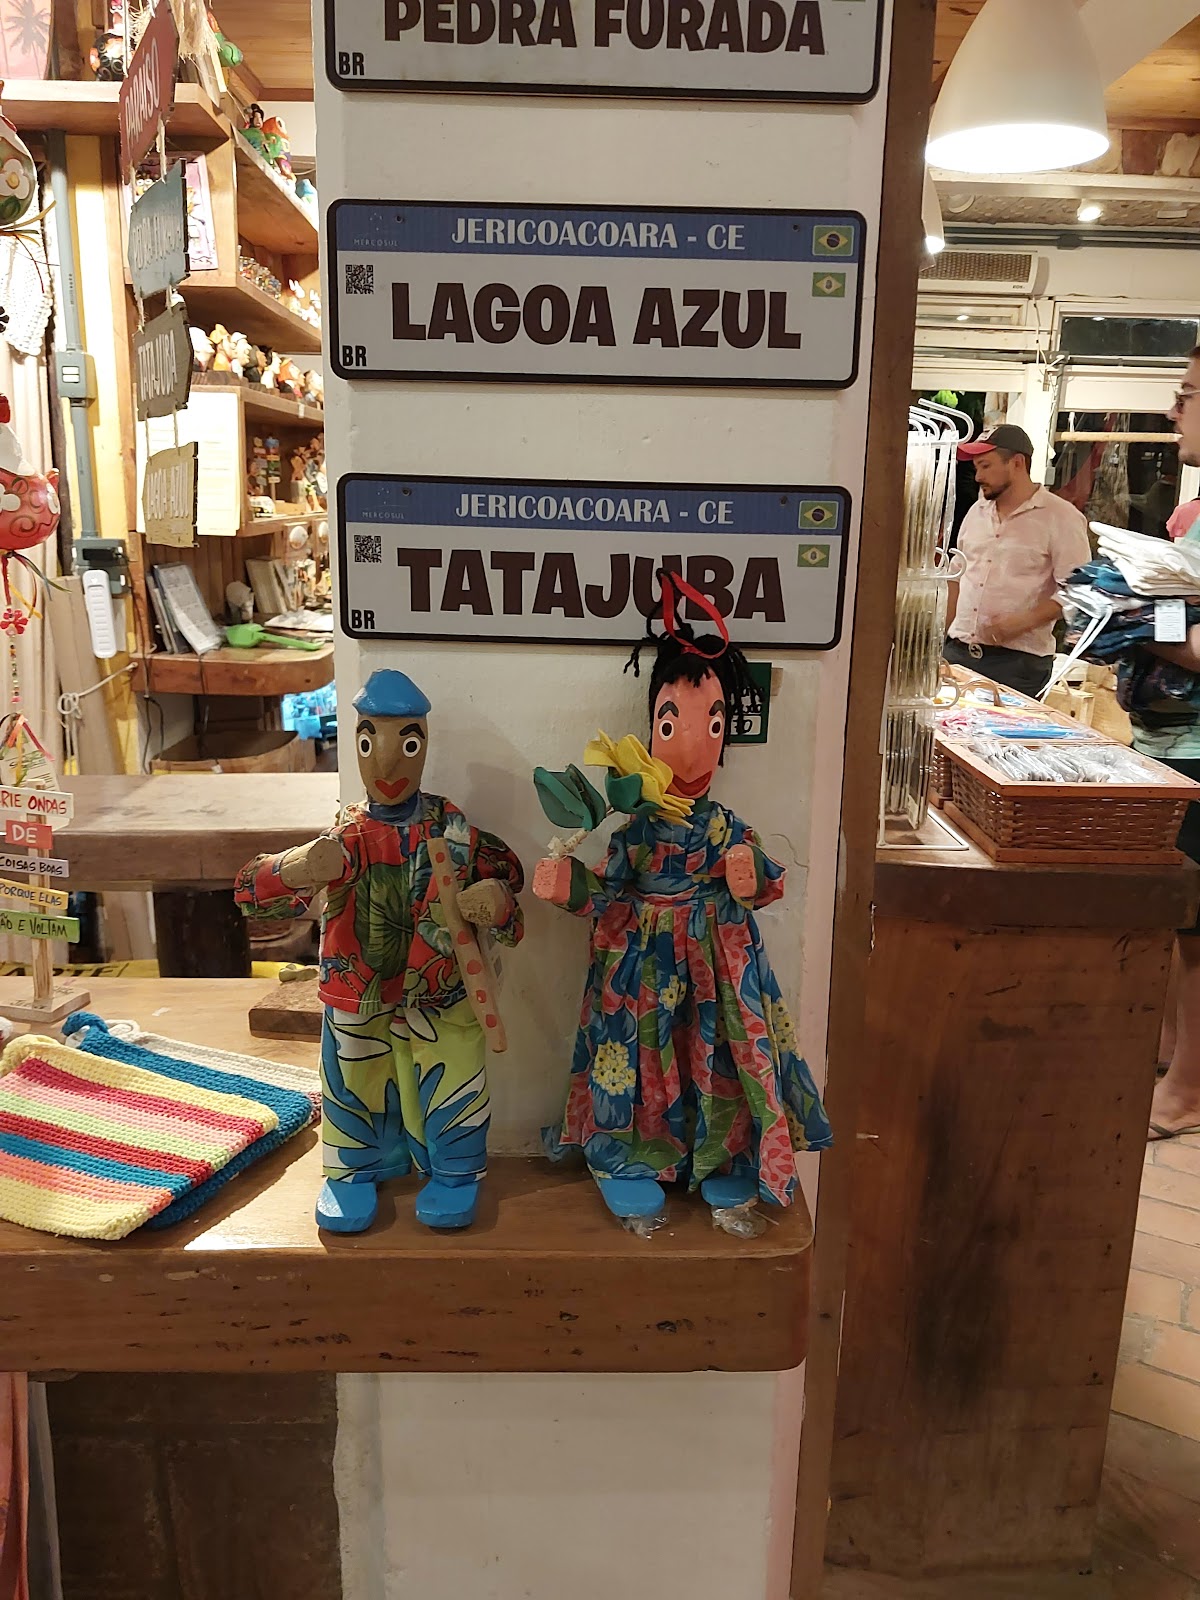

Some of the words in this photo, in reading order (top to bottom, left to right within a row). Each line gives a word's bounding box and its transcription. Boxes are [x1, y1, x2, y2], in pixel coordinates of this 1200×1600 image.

[385, 0, 577, 48] PEDRA
[594, 0, 825, 55] FURADA
[338, 52, 365, 76] BR
[353, 238, 399, 247] MERCOSUL
[452, 217, 678, 249] JERICOACOARA
[706, 224, 746, 250] CE
[391, 282, 616, 346] LAGOA
[632, 287, 802, 349] AZUL
[137, 329, 178, 402] TATAJUBA
[342, 345, 367, 367] BR
[362, 511, 404, 520] MERCOSUL
[455, 493, 670, 524] JERICOACOARA
[697, 500, 734, 524] CE
[396, 547, 786, 623] TATAJUBA
[351, 609, 375, 630] BR
[0, 790, 22, 808] RIE
[28, 795, 68, 815] ONDAS
[12, 824, 39, 844] DE
[0, 856, 36, 872] COISAS
[39, 861, 63, 876] BOAS
[0, 882, 36, 901] PORQUE
[39, 892, 63, 906] ELAS
[0, 912, 13, 930] ÃO
[18, 919, 26, 931] E
[30, 917, 68, 937] VOLTAM
